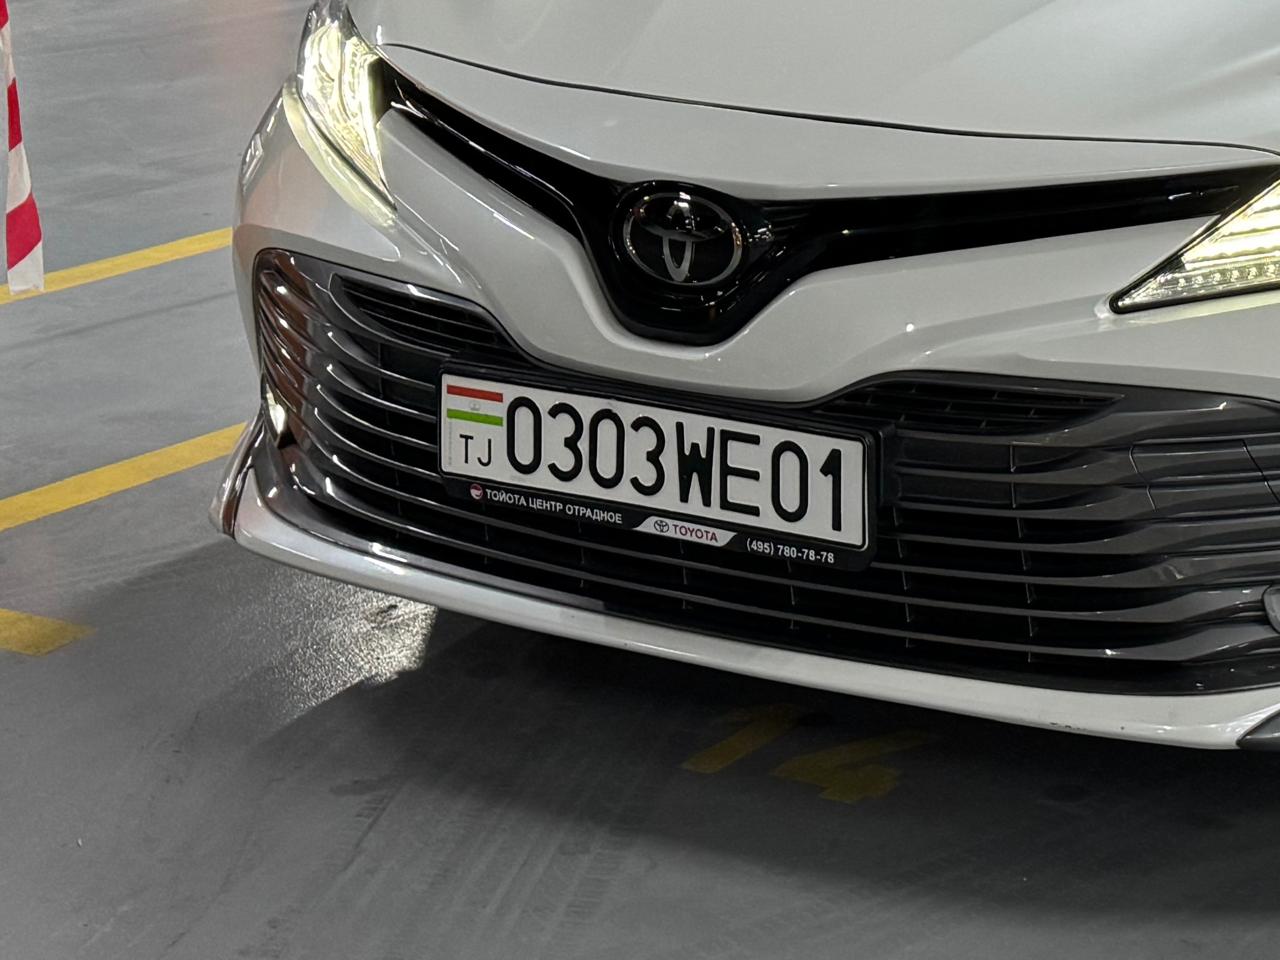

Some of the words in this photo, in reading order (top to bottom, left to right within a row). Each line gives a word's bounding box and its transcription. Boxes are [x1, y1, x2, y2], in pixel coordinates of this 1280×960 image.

[459, 434, 492, 467] TJ
[506, 396, 843, 532] 0303WE01
[485, 488, 527, 507] ТОЙОТА
[528, 497, 563, 514] ЦЕНТР
[565, 503, 623, 524] ОТРАДНОЕ
[672, 524, 719, 543] TOYOTA
[746, 538, 775, 557] (495)
[777, 544, 835, 564] 780-78-78
